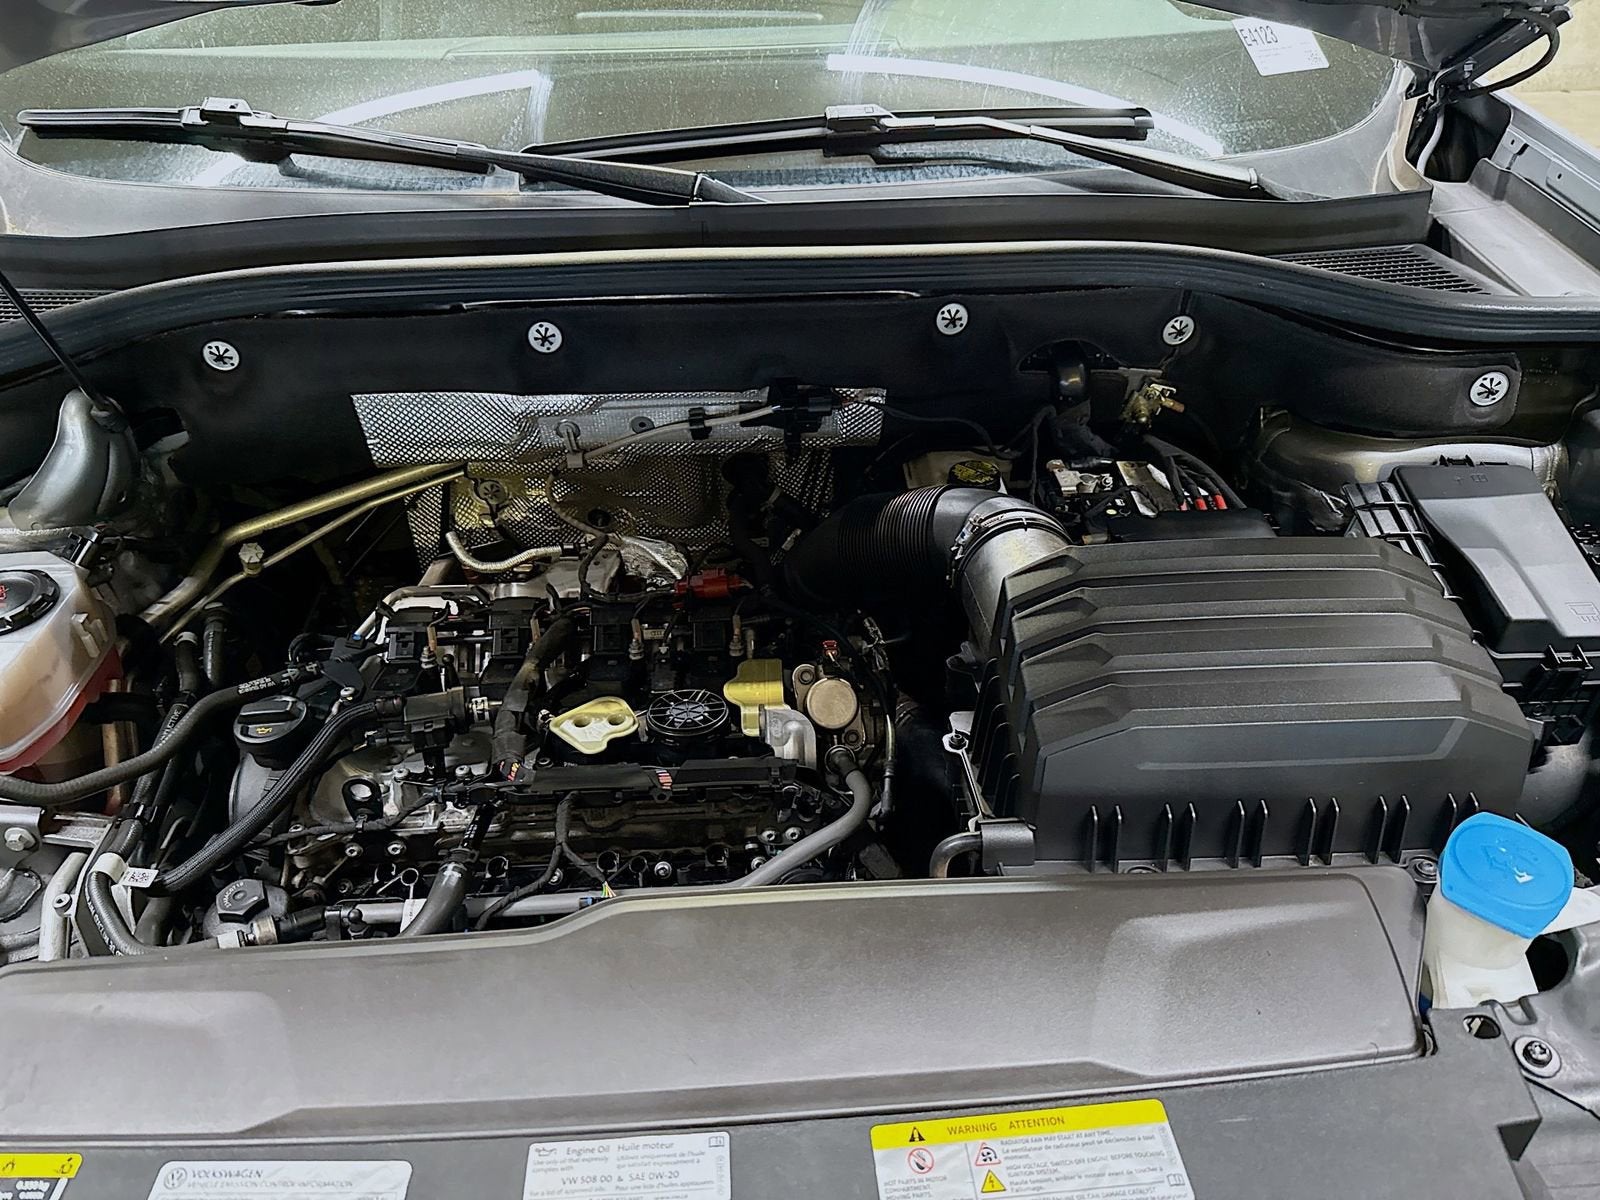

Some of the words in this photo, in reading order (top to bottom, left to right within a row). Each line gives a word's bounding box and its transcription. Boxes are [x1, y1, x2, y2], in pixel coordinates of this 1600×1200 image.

[1239, 25, 1278, 47] E4123
[946, 1122, 998, 1136] WARNING
[1008, 1116, 1066, 1131] ATTENTION
[566, 1145, 596, 1157] Engine
[597, 1144, 610, 1154] Oil
[617, 1142, 640, 1151] Huile
[642, 1141, 674, 1150] moteur
[561, 1175, 579, 1185] VW
[580, 1175, 598, 1185] 508
[600, 1174, 613, 1183] 00
[628, 1171, 646, 1181] SAE
